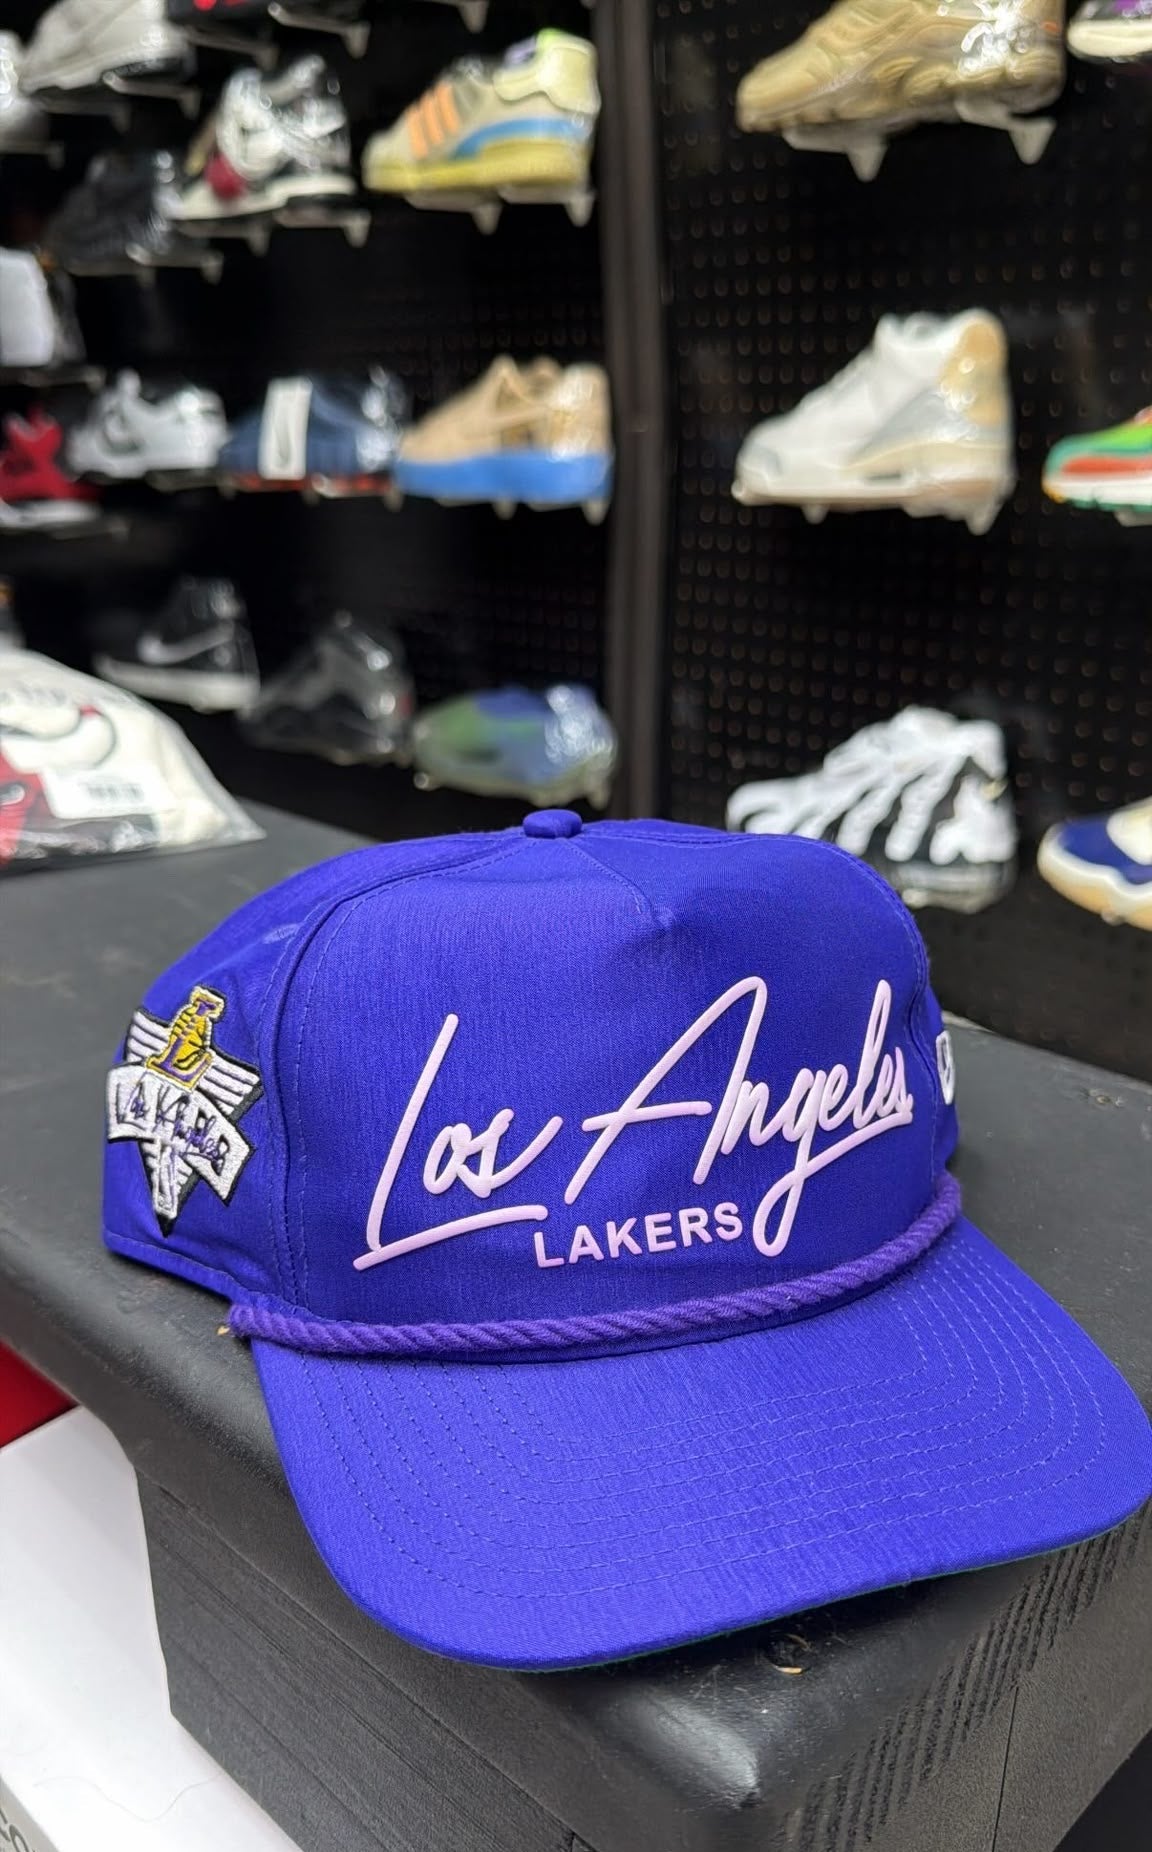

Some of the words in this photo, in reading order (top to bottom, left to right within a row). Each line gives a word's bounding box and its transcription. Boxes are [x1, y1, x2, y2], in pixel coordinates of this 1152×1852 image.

[352, 1013, 562, 1271] Los
[564, 976, 913, 1258] Angeles
[532, 1202, 743, 1269] LAKERS
